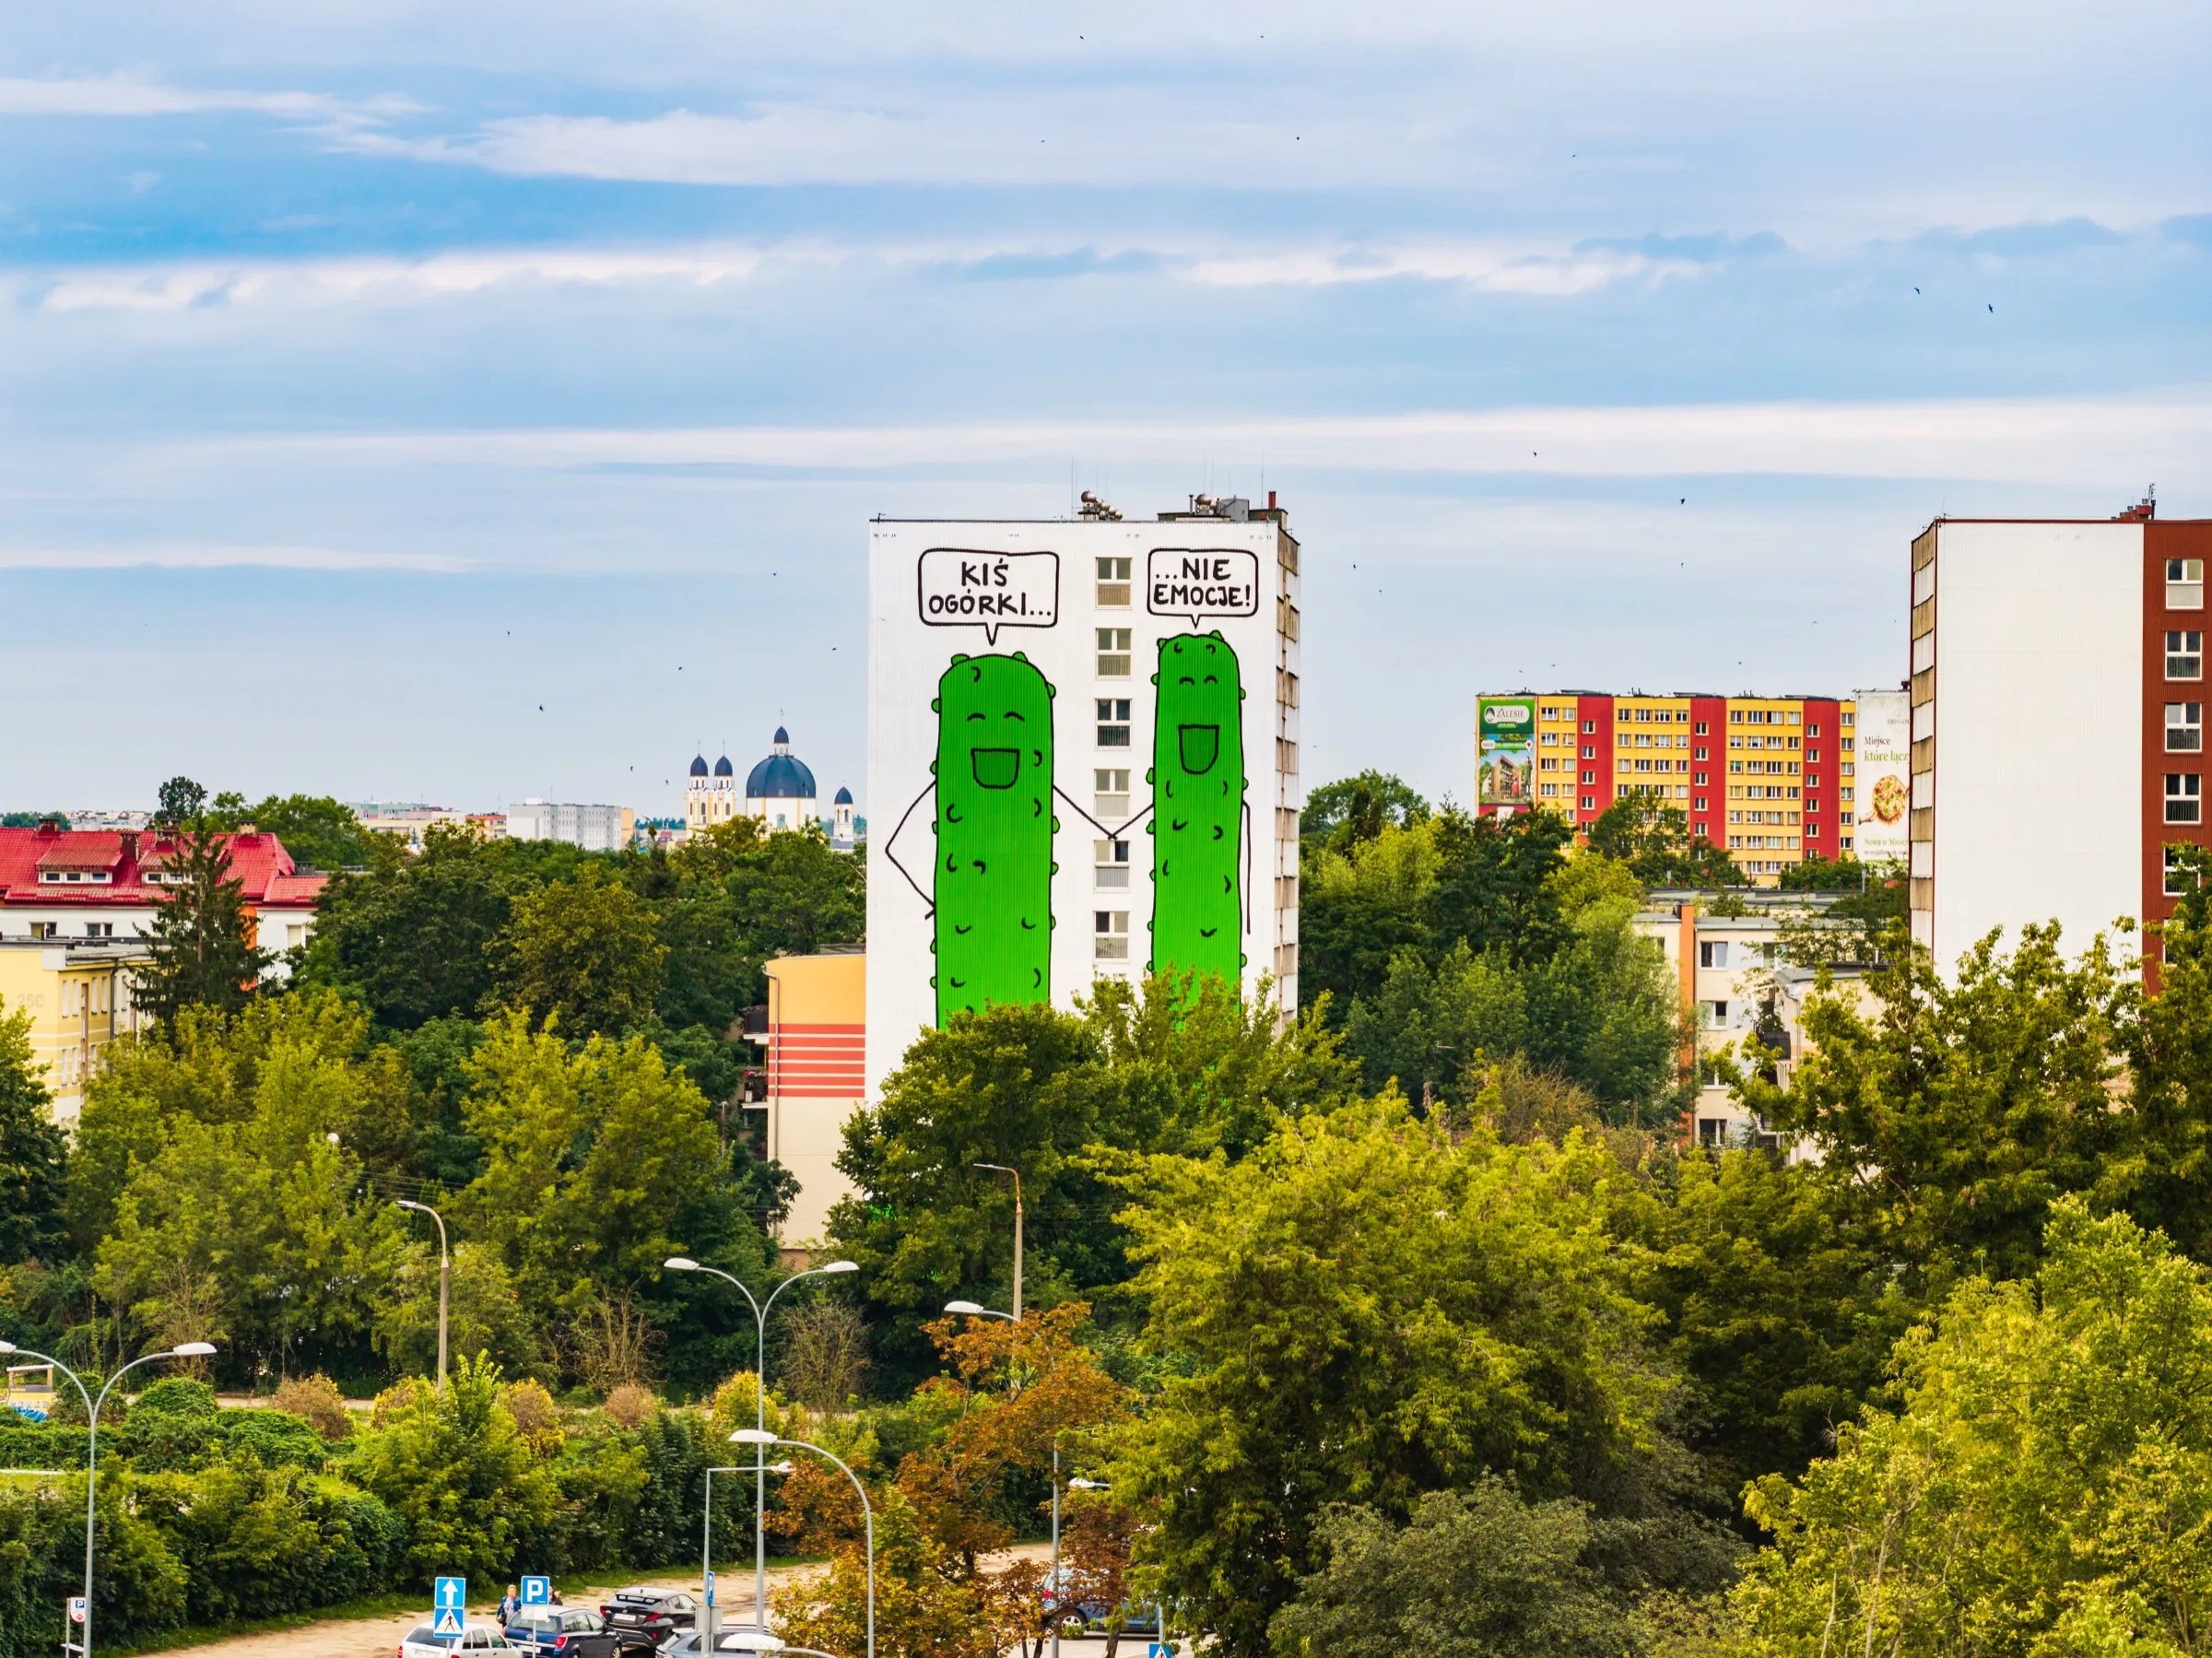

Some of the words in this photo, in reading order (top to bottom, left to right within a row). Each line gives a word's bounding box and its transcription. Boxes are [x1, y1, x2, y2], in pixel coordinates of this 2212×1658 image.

[961, 558, 1009, 587] KIŚ
[1156, 558, 1231, 581] ...NIE
[928, 589, 1052, 616] OGÓRKI...
[1154, 583, 1251, 607] EMOCJE!
[1865, 735, 1890, 747] Miejsce
[1865, 749, 1888, 762] które
[1890, 749, 1909, 765] łącz
[17, 993, 44, 1008] 25C
[527, 1580, 544, 1602] P
